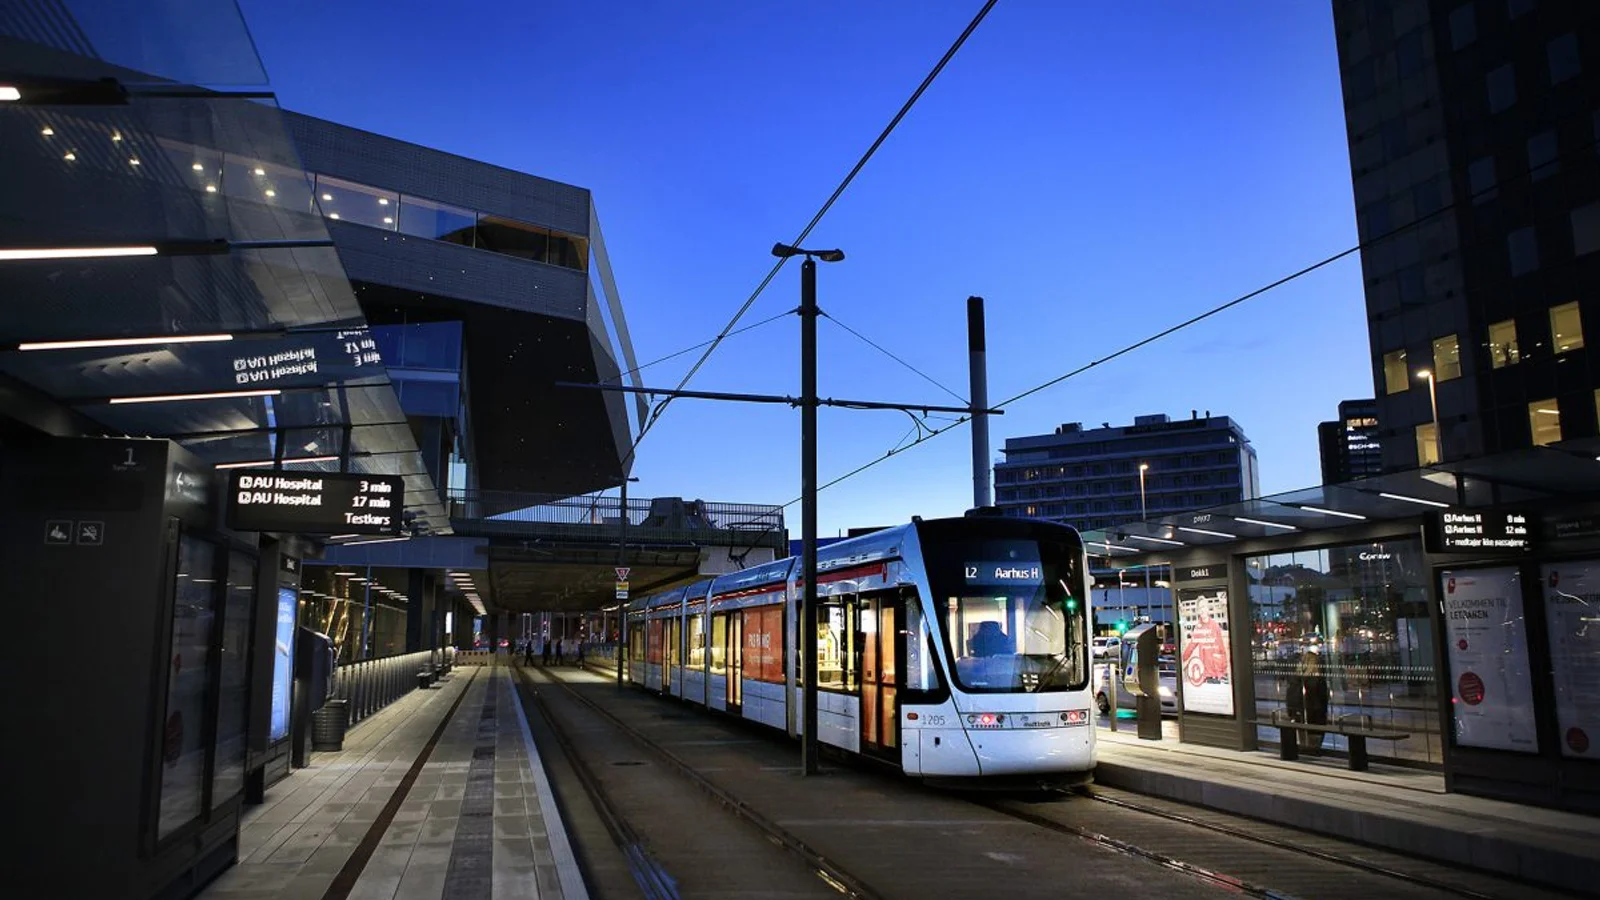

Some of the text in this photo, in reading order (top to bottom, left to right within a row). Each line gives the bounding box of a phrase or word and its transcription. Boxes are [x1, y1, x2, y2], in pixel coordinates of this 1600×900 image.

[123, 447, 136, 465] 1
[253, 477, 273, 489] AU
[274, 477, 323, 491] Hospital
[360, 481, 369, 492] 3
[370, 482, 391, 493] min
[252, 492, 272, 504] AU
[273, 493, 322, 506] Hospital
[352, 496, 367, 507] 17
[369, 496, 391, 508] min
[965, 567, 1039, 579] L2 Aarhus H
[922, 714, 946, 726] 1205
